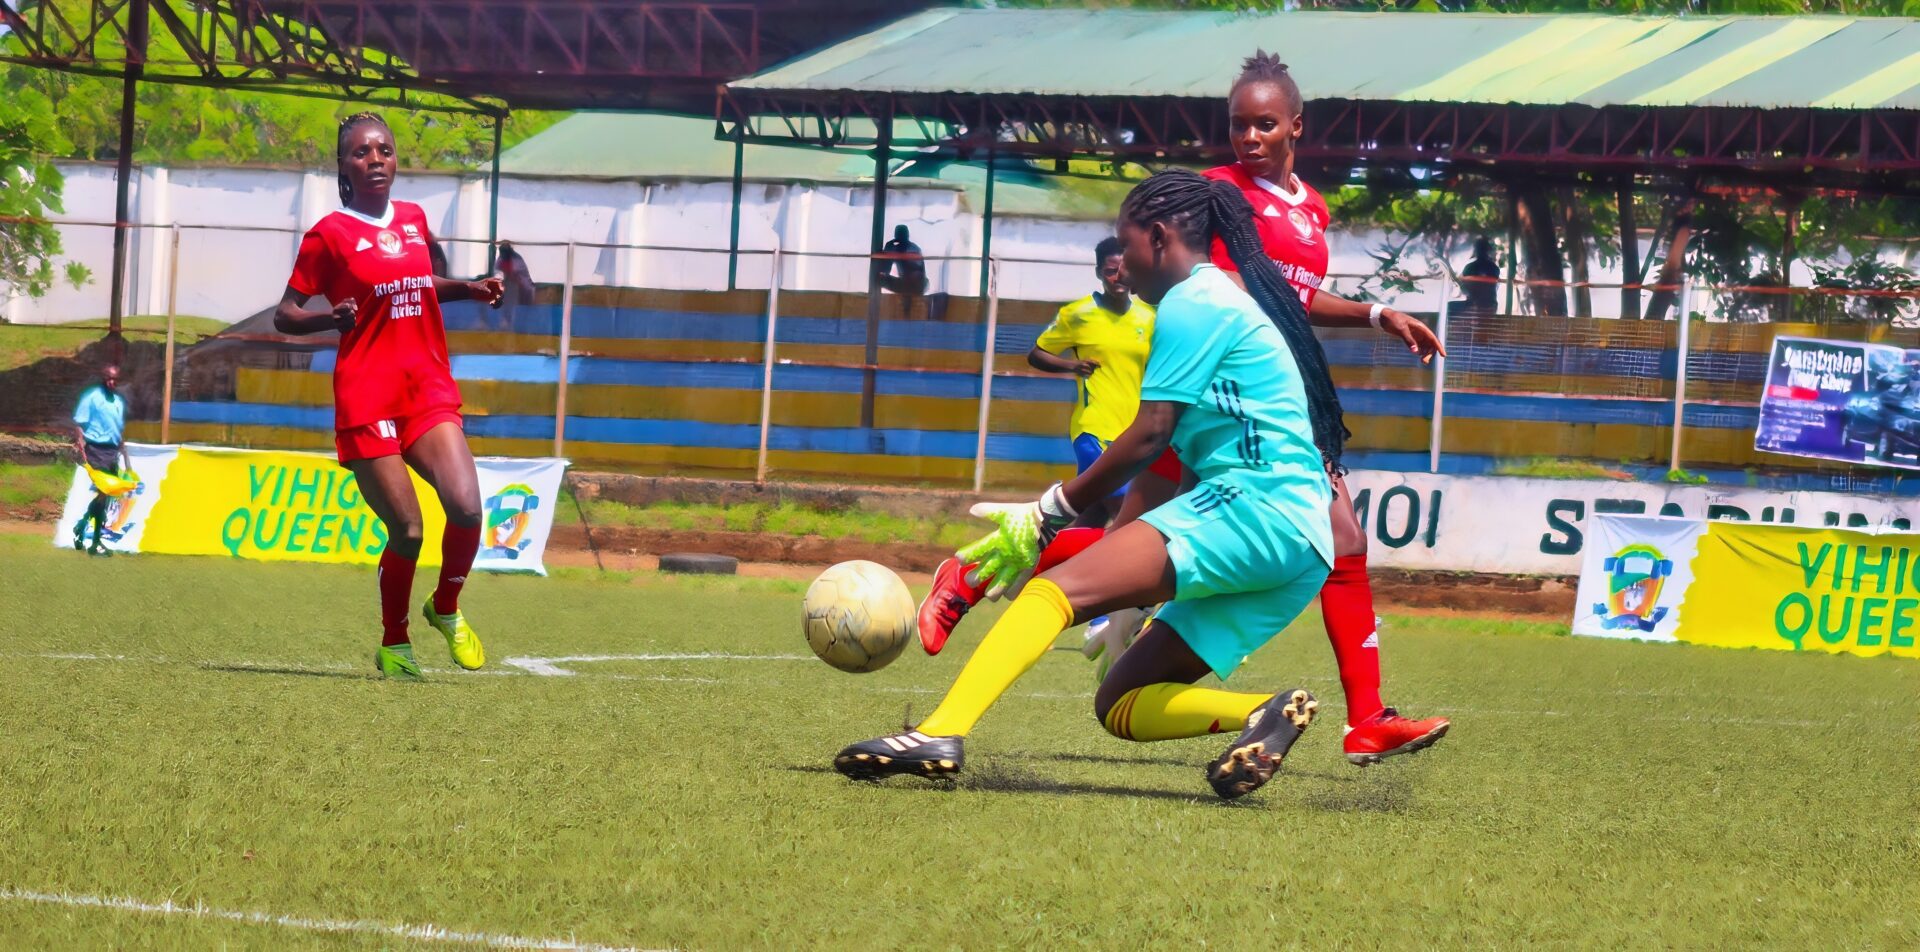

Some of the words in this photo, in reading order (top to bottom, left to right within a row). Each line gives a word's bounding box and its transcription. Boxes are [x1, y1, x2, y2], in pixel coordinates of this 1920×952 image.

[249, 464, 362, 511] VIHIG
[222, 507, 389, 558] QUEENS
[1797, 542, 1920, 596] VIHI
